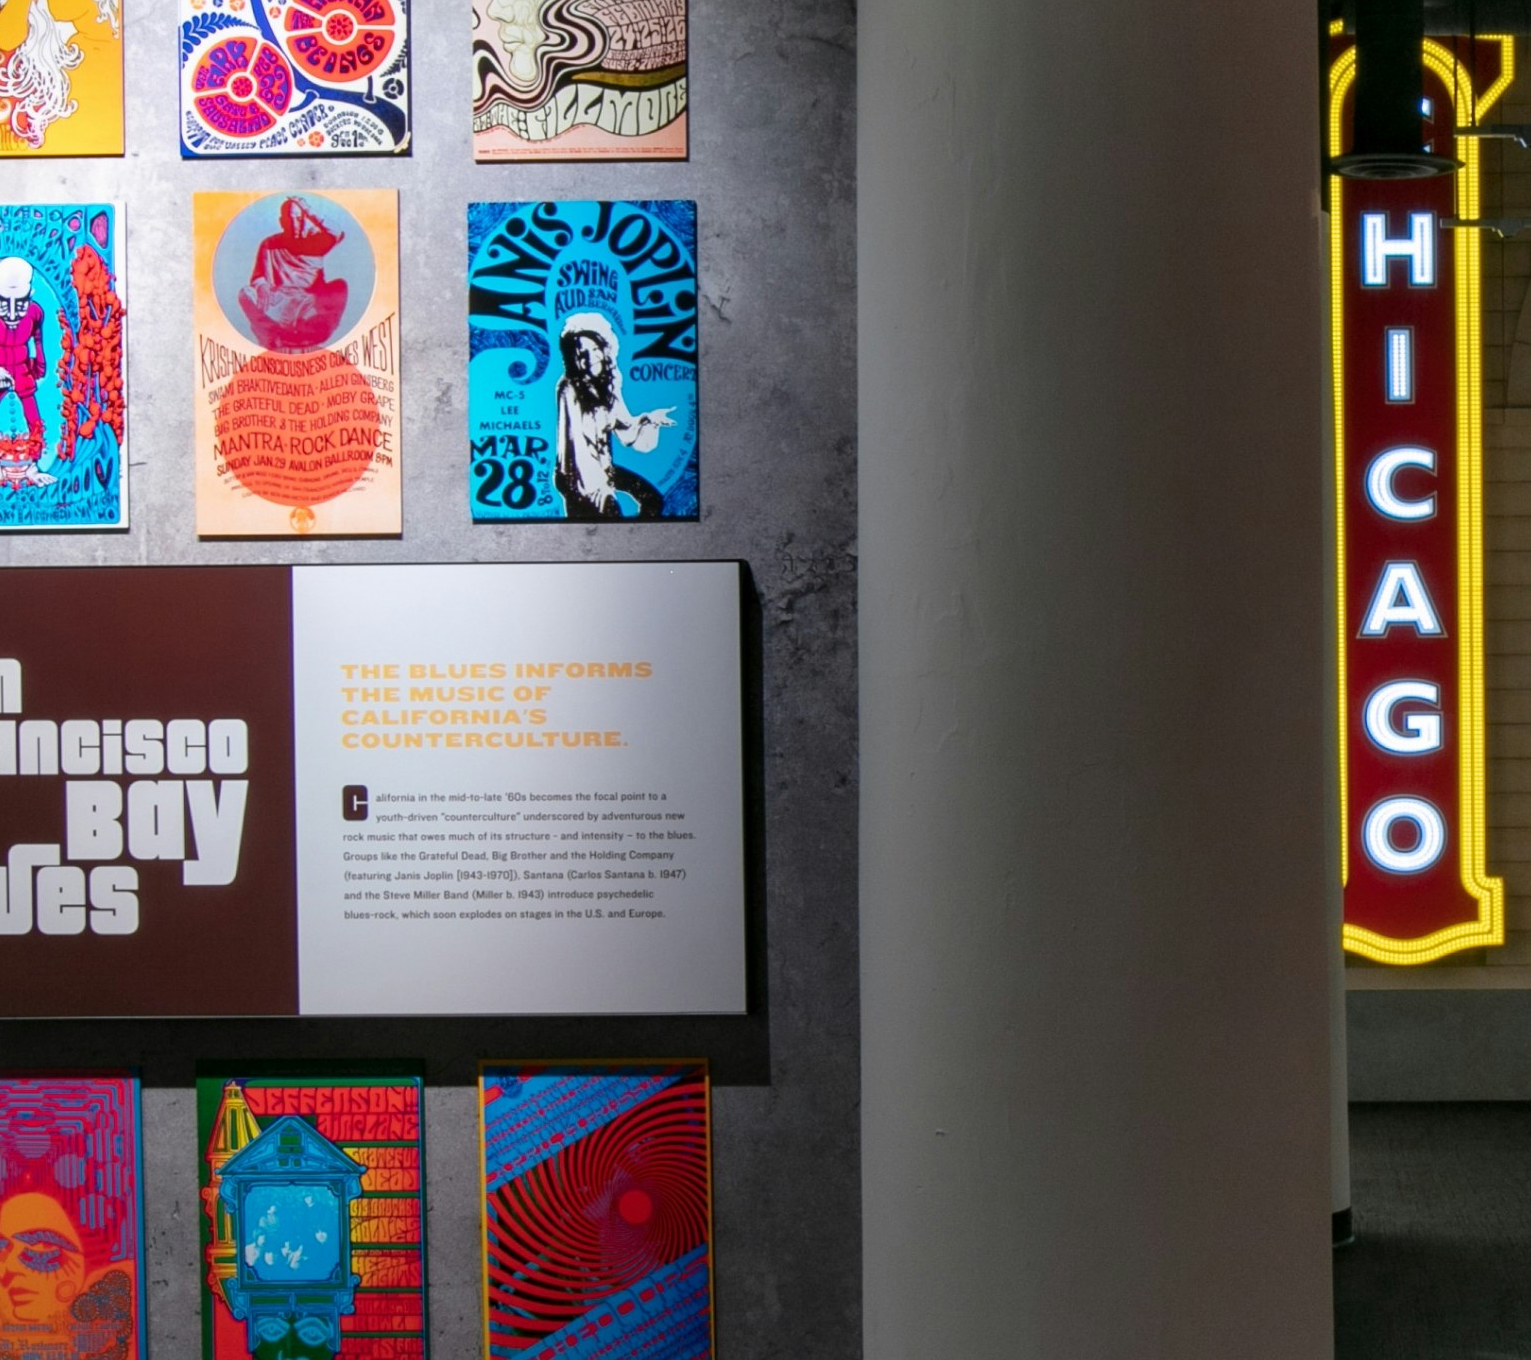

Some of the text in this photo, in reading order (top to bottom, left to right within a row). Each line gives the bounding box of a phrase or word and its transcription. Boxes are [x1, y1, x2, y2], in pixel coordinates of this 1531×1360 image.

[199, 312, 396, 389] KRISHNA CONSCIOUSNESS COMES WEST
[211, 391, 396, 422] THE GRATEFUL DEAD MOBY GRAPE
[501, 406, 519, 415] LEE
[479, 420, 541, 430] MICHAELS
[340, 427, 394, 453] DANCE
[216, 455, 251, 477] SUNDAY
[288, 459, 323, 473] AVALON
[324, 450, 374, 468] BALLROOM
[474, 459, 537, 510] 28
[1358, 97, 1448, 875] HICAGO
[341, 661, 652, 680] THE BLUES INFORMS
[341, 685, 549, 703] THE MUSIC OF
[341, 708, 547, 727] CALIFORNIA'S
[341, 731, 628, 750] COUNTERCULTURE.
[418, 793, 428, 802] in
[430, 793, 446, 803] the
[448, 793, 502, 802] mid-to-late
[529, 792, 573, 802] becomes
[575, 792, 591, 801] the
[593, 791, 618, 801] focal
[620, 792, 646, 803] point
[648, 793, 659, 801] to
[661, 793, 667, 801] a
[375, 813, 438, 823] youth-driven
[523, 811, 585, 821] underscored
[587, 811, 599, 823] by
[601, 811, 663, 821] adventurous
[66, 780, 249, 886] Bay
[342, 832, 364, 841] rock
[367, 833, 395, 841] music
[398, 832, 418, 841] that
[448, 831, 475, 841] much
[477, 831, 488, 841] of
[490, 833, 503, 841] its
[505, 832, 551, 841] structure
[560, 831, 579, 841] and
[581, 831, 624, 842] intensity
[635, 832, 646, 840] to
[648, 831, 665, 840] the
[667, 830, 696, 840] blues.
[343, 849, 675, 862] Groups like the Grateful Dead, Big Brother and the Holding Company
[344, 871, 392, 882] (featuring
[394, 871, 421, 881] Janis
[423, 871, 454, 882] Joplin
[523, 870, 564, 880] Santana
[567, 869, 602, 881] (Carlos
[604, 869, 645, 879] Santana
[647, 869, 657, 879] b.
[660, 868, 687, 881] 1947)
